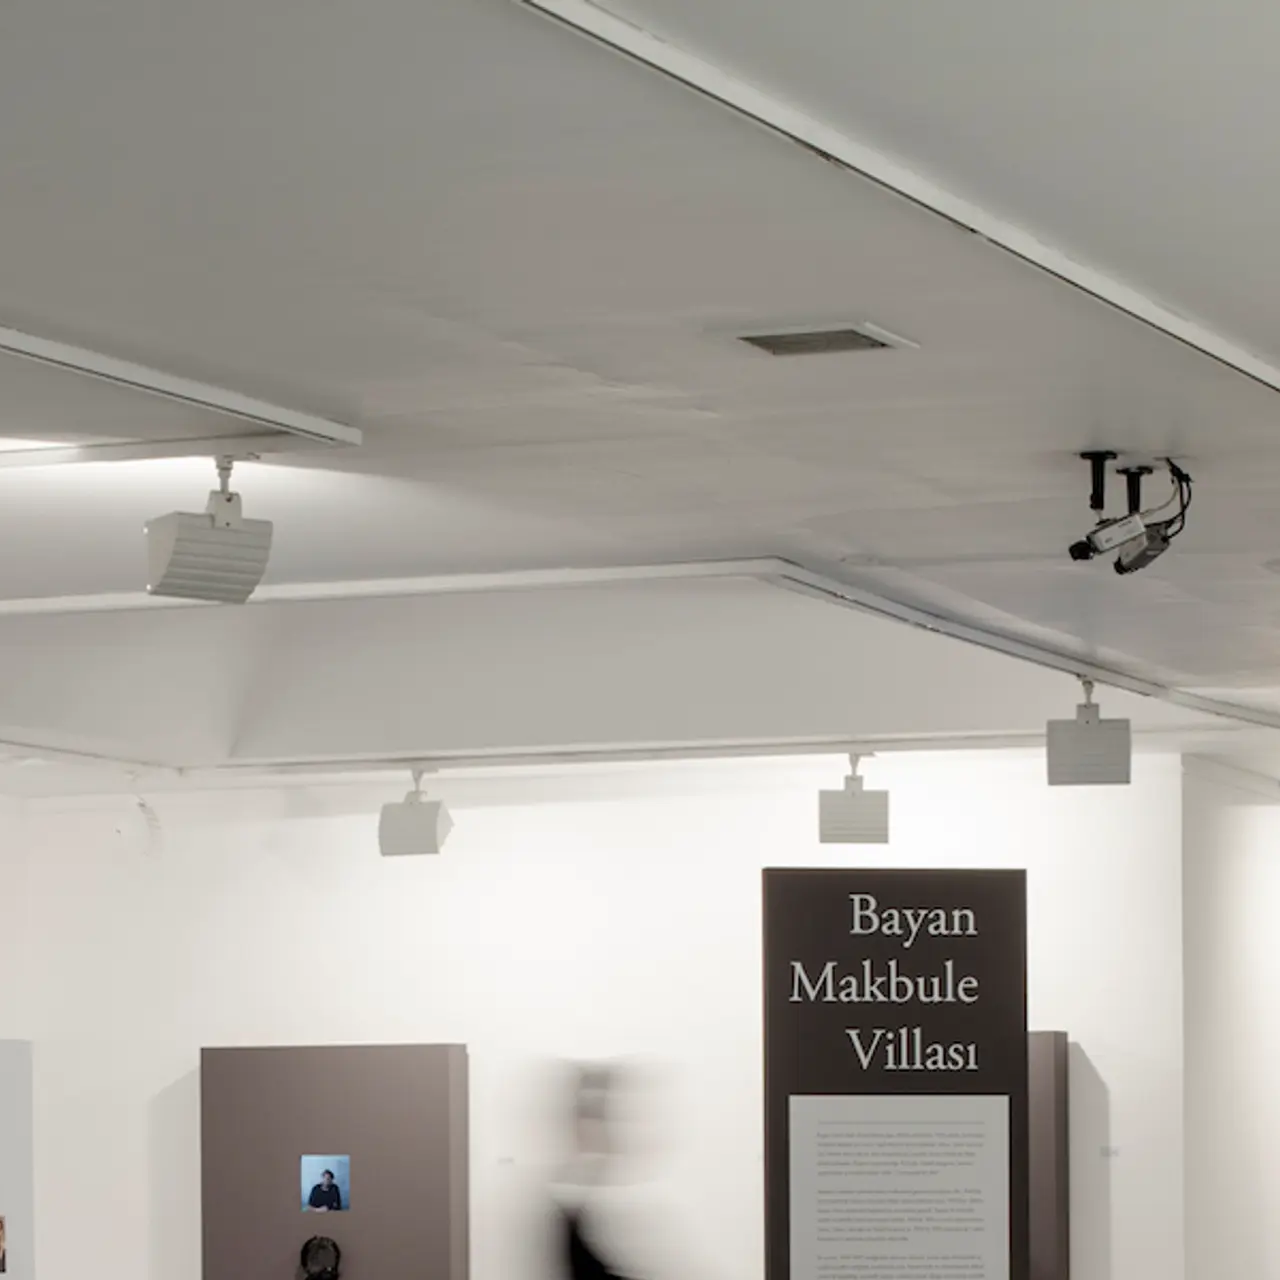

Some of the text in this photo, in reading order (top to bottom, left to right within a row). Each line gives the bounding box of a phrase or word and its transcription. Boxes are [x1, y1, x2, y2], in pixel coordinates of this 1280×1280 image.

[849, 894, 978, 948] Bayan
[789, 959, 979, 1003] Makbule
[845, 1026, 978, 1070] Villası
